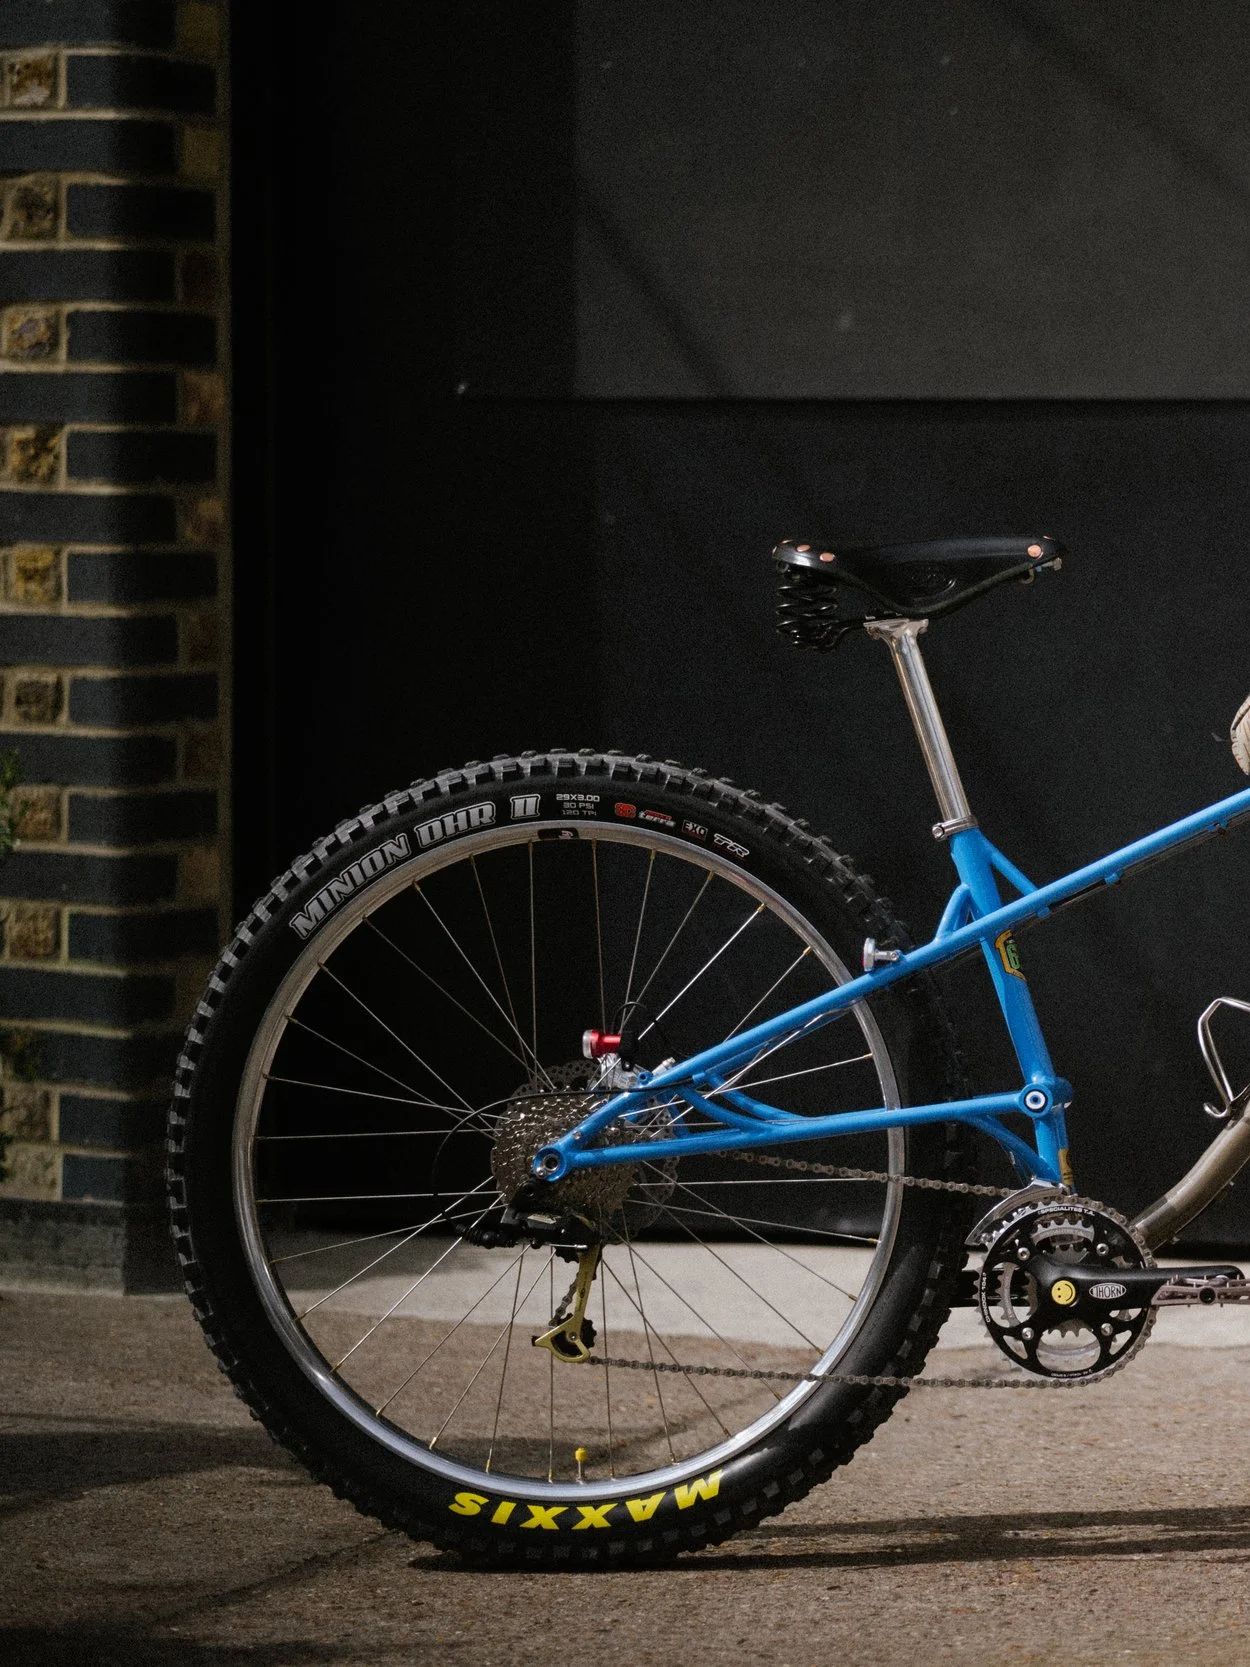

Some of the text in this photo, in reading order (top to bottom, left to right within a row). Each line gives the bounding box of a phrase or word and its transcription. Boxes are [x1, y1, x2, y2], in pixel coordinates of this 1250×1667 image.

[579, 802, 595, 810] PSI
[713, 833, 750, 858] TR
[289, 793, 541, 940] MINION DHR II
[1092, 1285, 1123, 1299] THORN
[448, 1468, 724, 1530] MAXXIS
